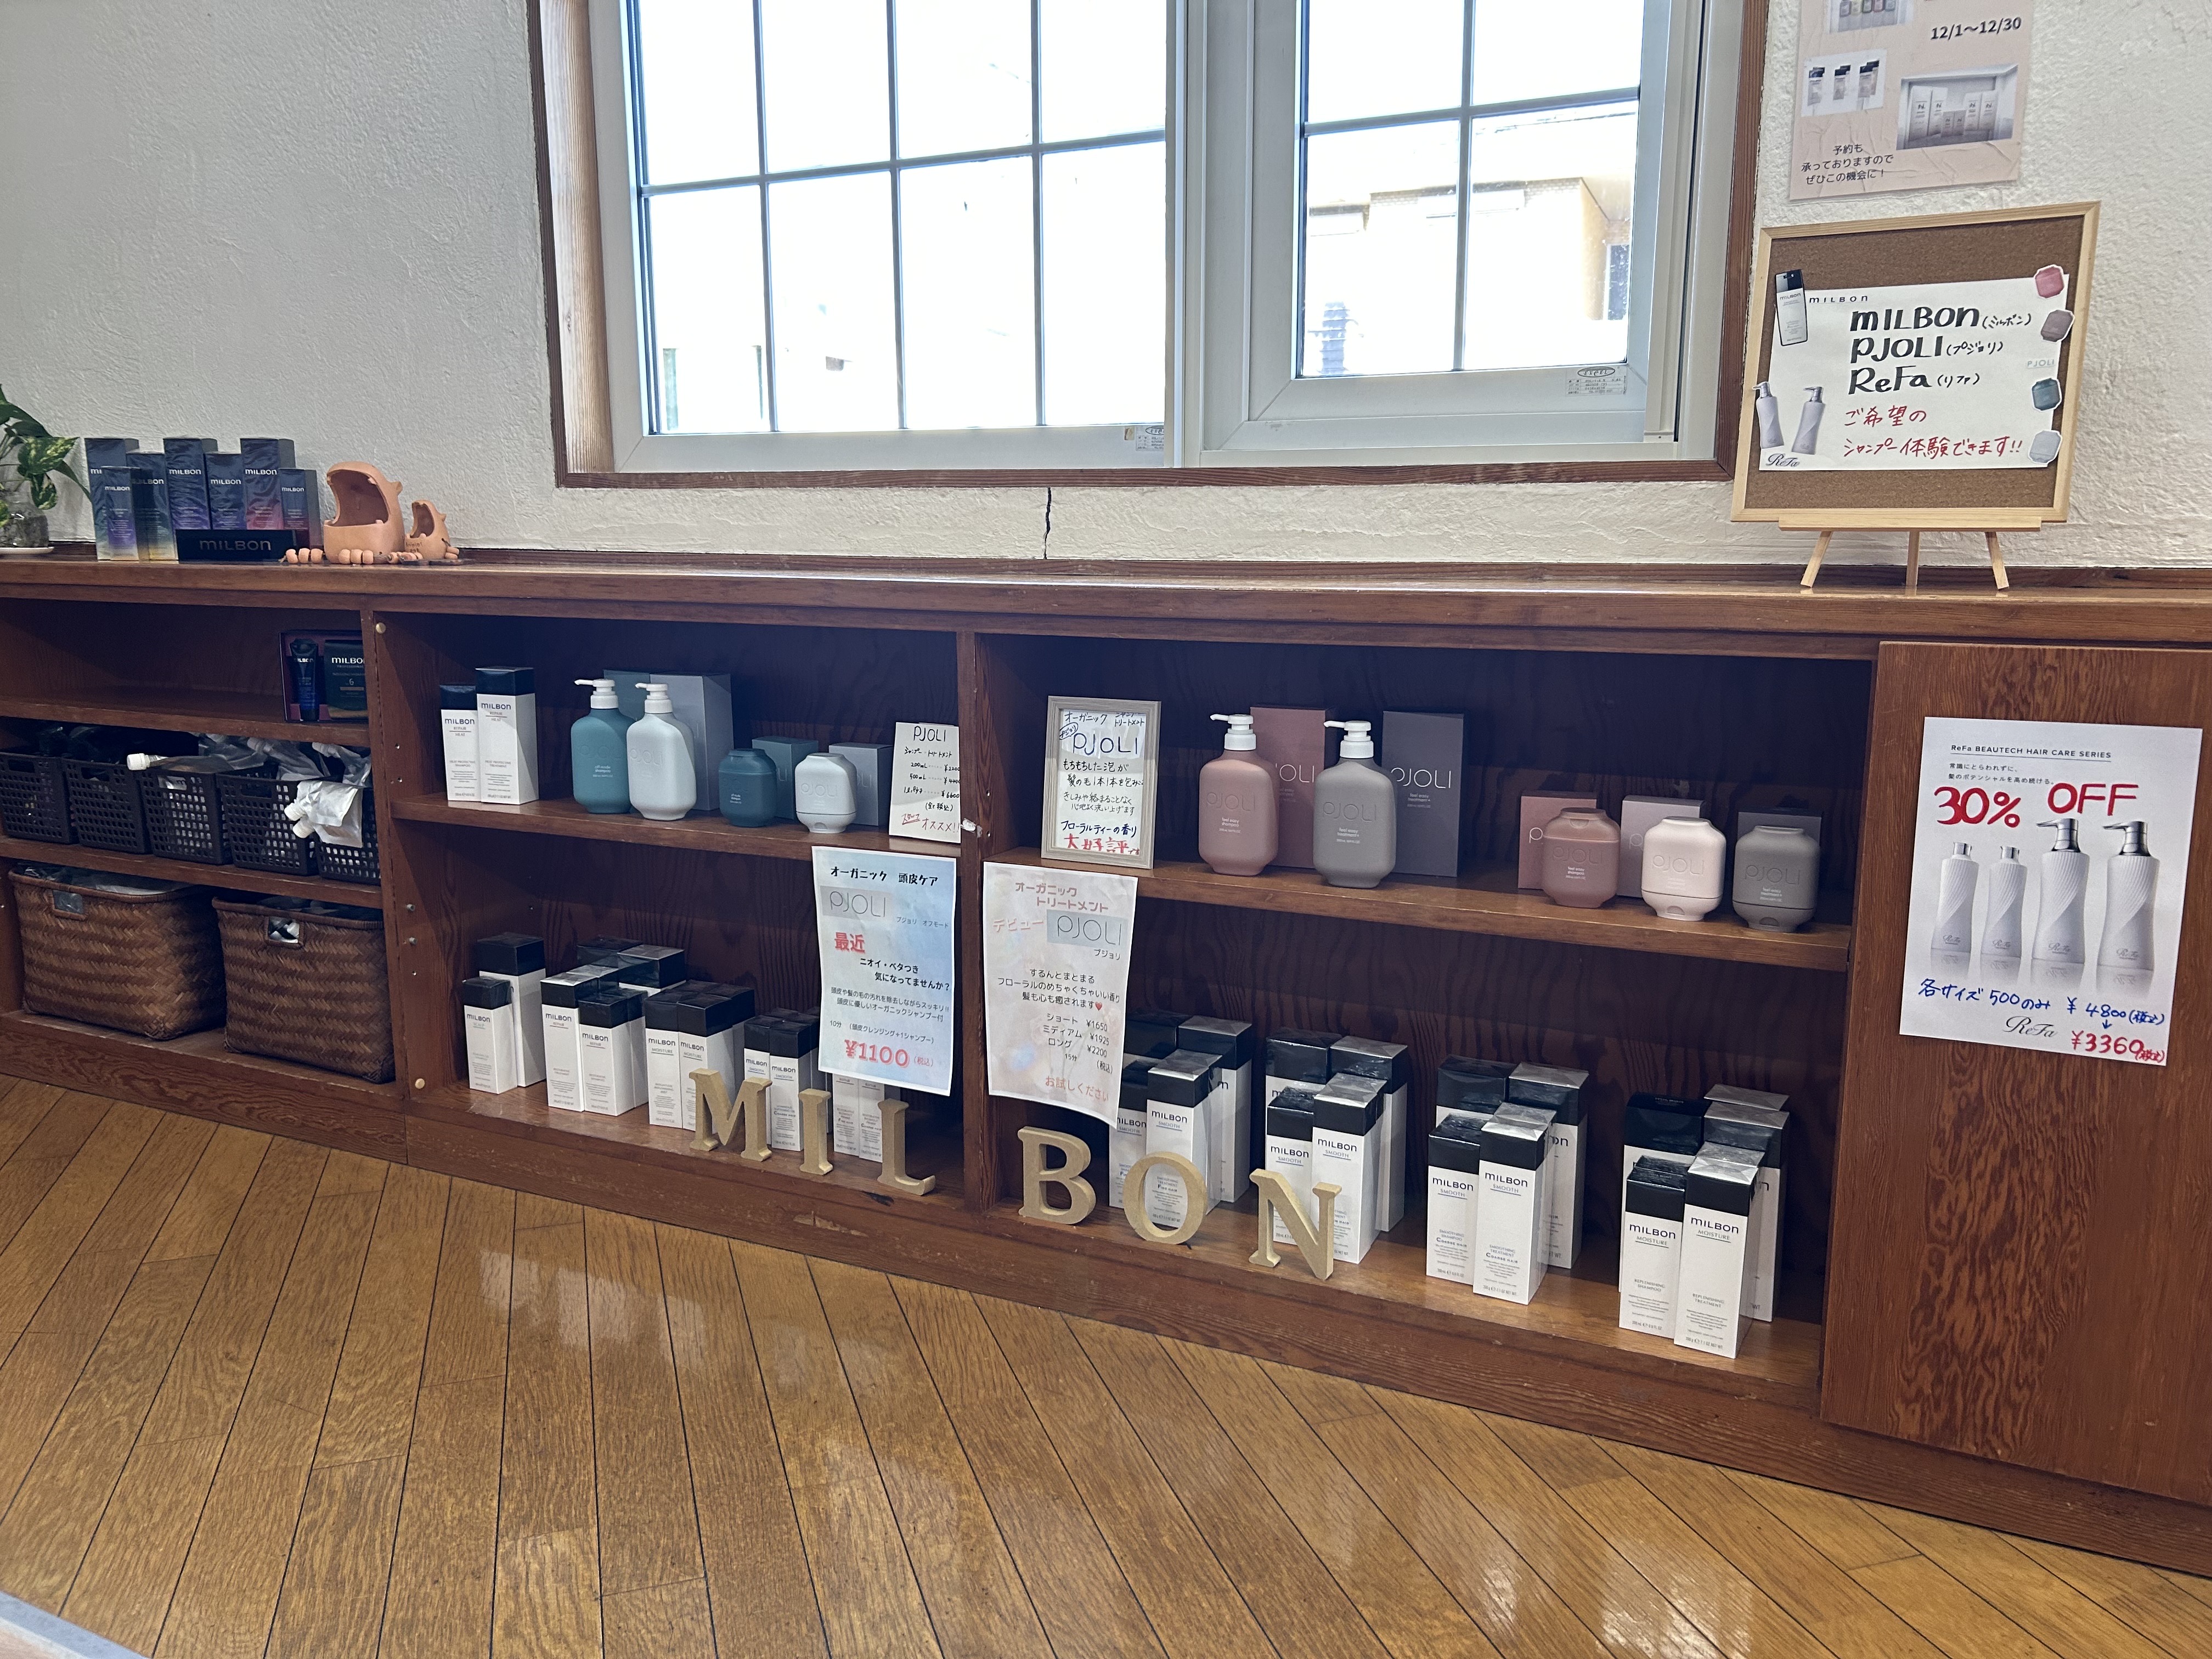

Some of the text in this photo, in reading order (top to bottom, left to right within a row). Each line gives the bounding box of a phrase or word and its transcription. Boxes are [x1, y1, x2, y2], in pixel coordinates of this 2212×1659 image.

[1833, 144, 1863, 155] 予約も
[1801, 154, 1894, 172] 承っておりますので
[1850, 336, 1943, 363] PJOLI
[2027, 359, 2056, 368] PJOLI
[1848, 365, 1932, 395] ReFa
[1844, 405, 1927, 427] ご希望の
[1064, 711, 1108, 725] オーガニック
[913, 726, 946, 742] PJOLI
[1073, 733, 1138, 755] PJOLI
[1063, 759, 1129, 772] もちもちした泡が
[1934, 782, 2138, 829] 30% OFF
[1061, 820, 1137, 838] フローラルティーの香り
[831, 866, 938, 886] オーガニック 頭皮ケア
[1015, 882, 1077, 897] オーガニック
[830, 891, 886, 917] PJOLI
[1037, 896, 1108, 912] トリートメント
[923, 919, 949, 928] オフモード
[992, 918, 1044, 932] デビュー
[1057, 916, 1122, 946] PJOLI
[834, 932, 866, 953] 最近
[1093, 949, 1120, 960] プジョリ
[1030, 969, 1095, 984] するんとまとまる
[998, 978, 1120, 1003] フローラルのめちゃくちゃいい香り
[837, 997, 943, 1022] 頭皮に優しいオーガニックシャンプー付
[1047, 1013, 1108, 1031] ショート ¥1650
[2003, 1015, 2058, 1038] ReFa
[1043, 1025, 1109, 1046] ミディアム ¥1925
[844, 1040, 910, 1068] ¥1100
[1048, 1038, 1107, 1058] ロング ¥2200
[1065, 1053, 1077, 1062] 15分
[1045, 1075, 1109, 1102] お試しください
[1325, 1149, 1350, 1158] SMOOTH
[1440, 1188, 1465, 1198] SMOOTH
[1493, 1184, 1519, 1194] SMOOTH
[1629, 1223, 1675, 1239] MILBON
[1691, 1217, 1739, 1234] MILBON
[1637, 1235, 1668, 1246] MOISTURE
[1698, 1229, 1730, 1240] MOISTURE
[1695, 1299, 1721, 1307] TREATMENT
